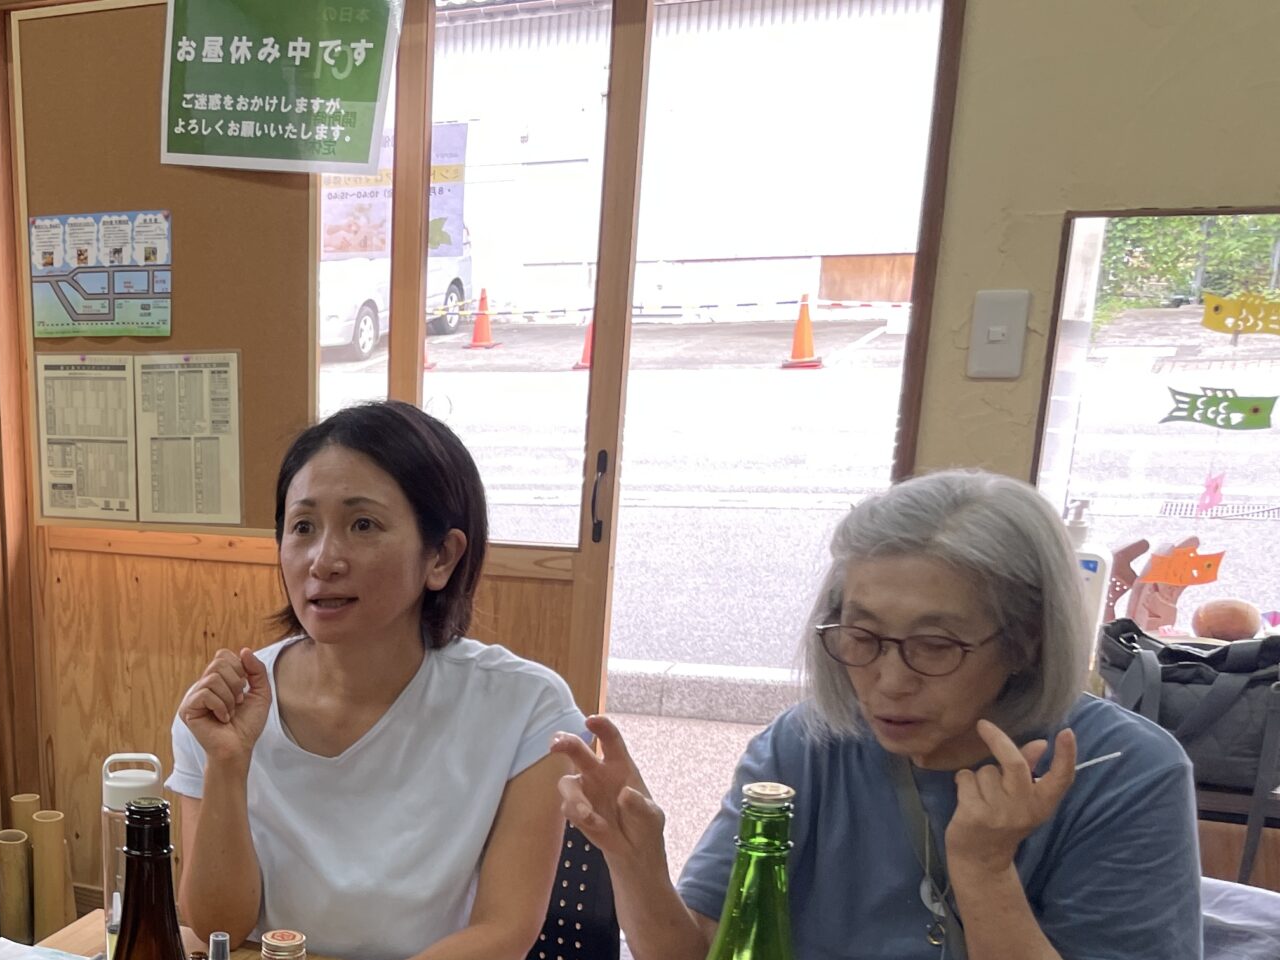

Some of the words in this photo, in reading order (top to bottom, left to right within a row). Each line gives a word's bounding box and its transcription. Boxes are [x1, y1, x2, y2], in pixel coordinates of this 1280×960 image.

[176, 36, 374, 65] お昼休み中です
[174, 118, 351, 142] よろしくお願いいたします。
